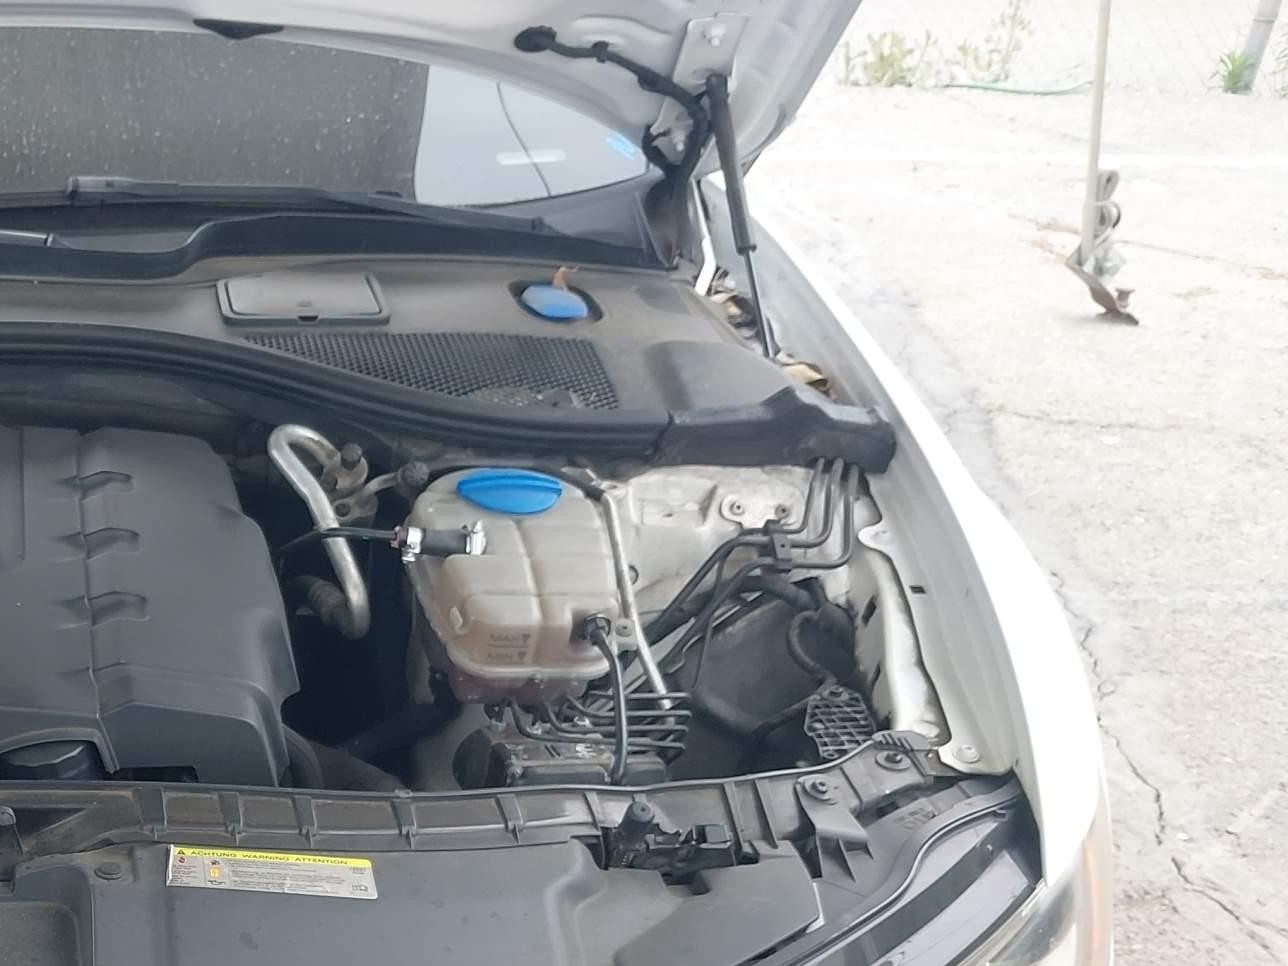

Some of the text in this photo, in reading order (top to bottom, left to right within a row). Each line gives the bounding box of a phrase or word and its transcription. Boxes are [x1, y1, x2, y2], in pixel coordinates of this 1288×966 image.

[190, 849, 348, 865] ACHTUNG WARNING ATTENTION
